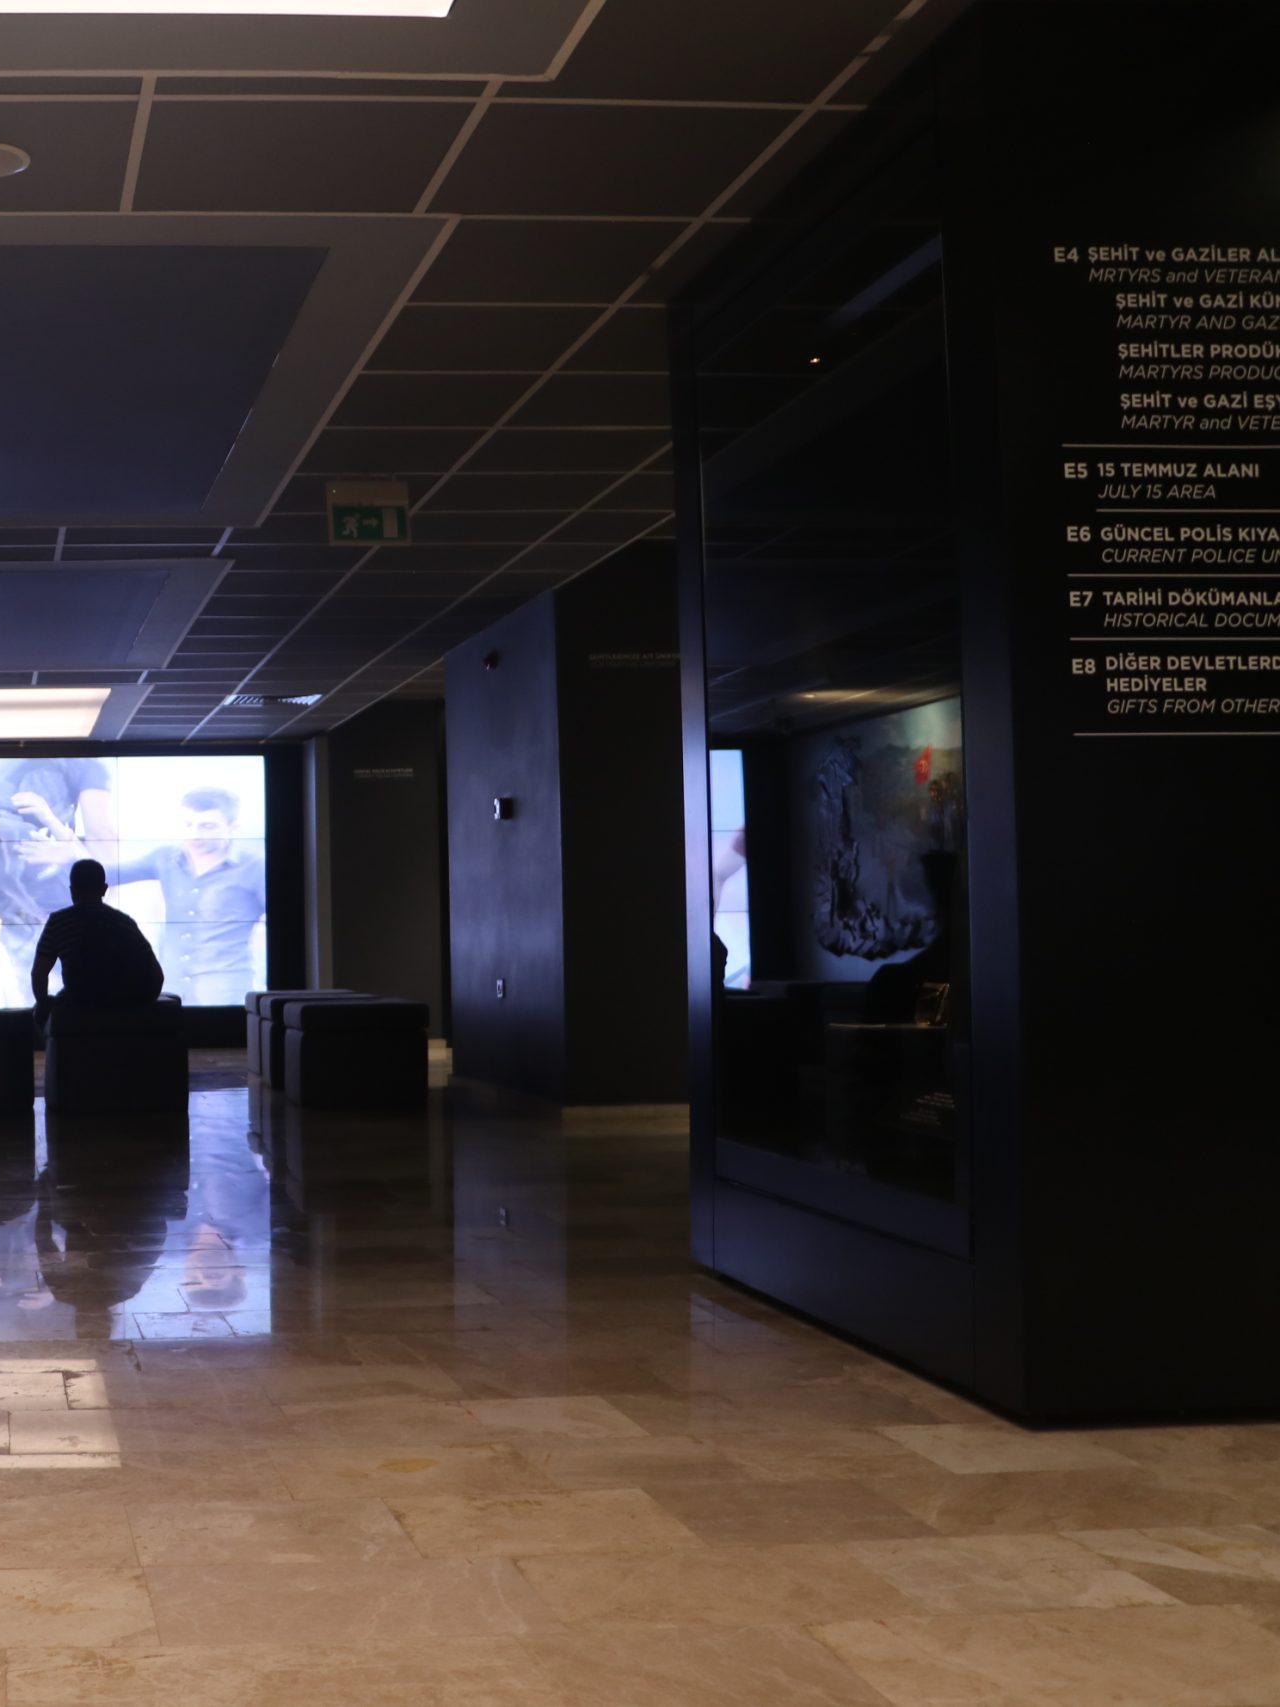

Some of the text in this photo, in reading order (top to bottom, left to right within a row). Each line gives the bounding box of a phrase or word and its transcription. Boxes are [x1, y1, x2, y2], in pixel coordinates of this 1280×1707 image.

[1054, 247, 1079, 263] E4
[1088, 244, 1140, 263] ŞEHİT
[1145, 250, 1166, 261] ve
[1171, 245, 1251, 262] GAZİLER
[1089, 268, 1161, 283] MRTYRS
[1166, 269, 1198, 283] and
[1116, 290, 1168, 310] ŞEHİT
[1173, 296, 1194, 308] ve
[1199, 291, 1243, 308] GAZİ
[1117, 314, 1191, 329] MARTYR
[1196, 315, 1236, 330] AND
[1118, 340, 1204, 360] ŞEHİTLER
[1119, 365, 1203, 379] MARTYRS
[1120, 390, 1172, 410] ŞEHİT
[1177, 397, 1198, 408] ve
[1203, 391, 1247, 408] GAZİ
[1121, 415, 1195, 429] MARTYR
[1200, 415, 1232, 430] and
[1064, 462, 1259, 479] E5 15 TEMMUZ ALANI
[1098, 484, 1216, 499] JULY 15 AREA
[1067, 524, 1280, 542] E6 GÜNCEL POLİS KIYA
[1102, 548, 1187, 563] CURRENT
[1191, 548, 1256, 563] POLICE
[1069, 591, 1093, 607] E7
[1102, 588, 1162, 606] TARİHİ
[1104, 612, 1208, 627] HISTORICAL
[1072, 658, 1096, 675] E8
[1106, 652, 1161, 671] DİĞER
[1106, 674, 1207, 692] HEDİYELER
[1107, 698, 1280, 714] GIFTS FROM OTHER
